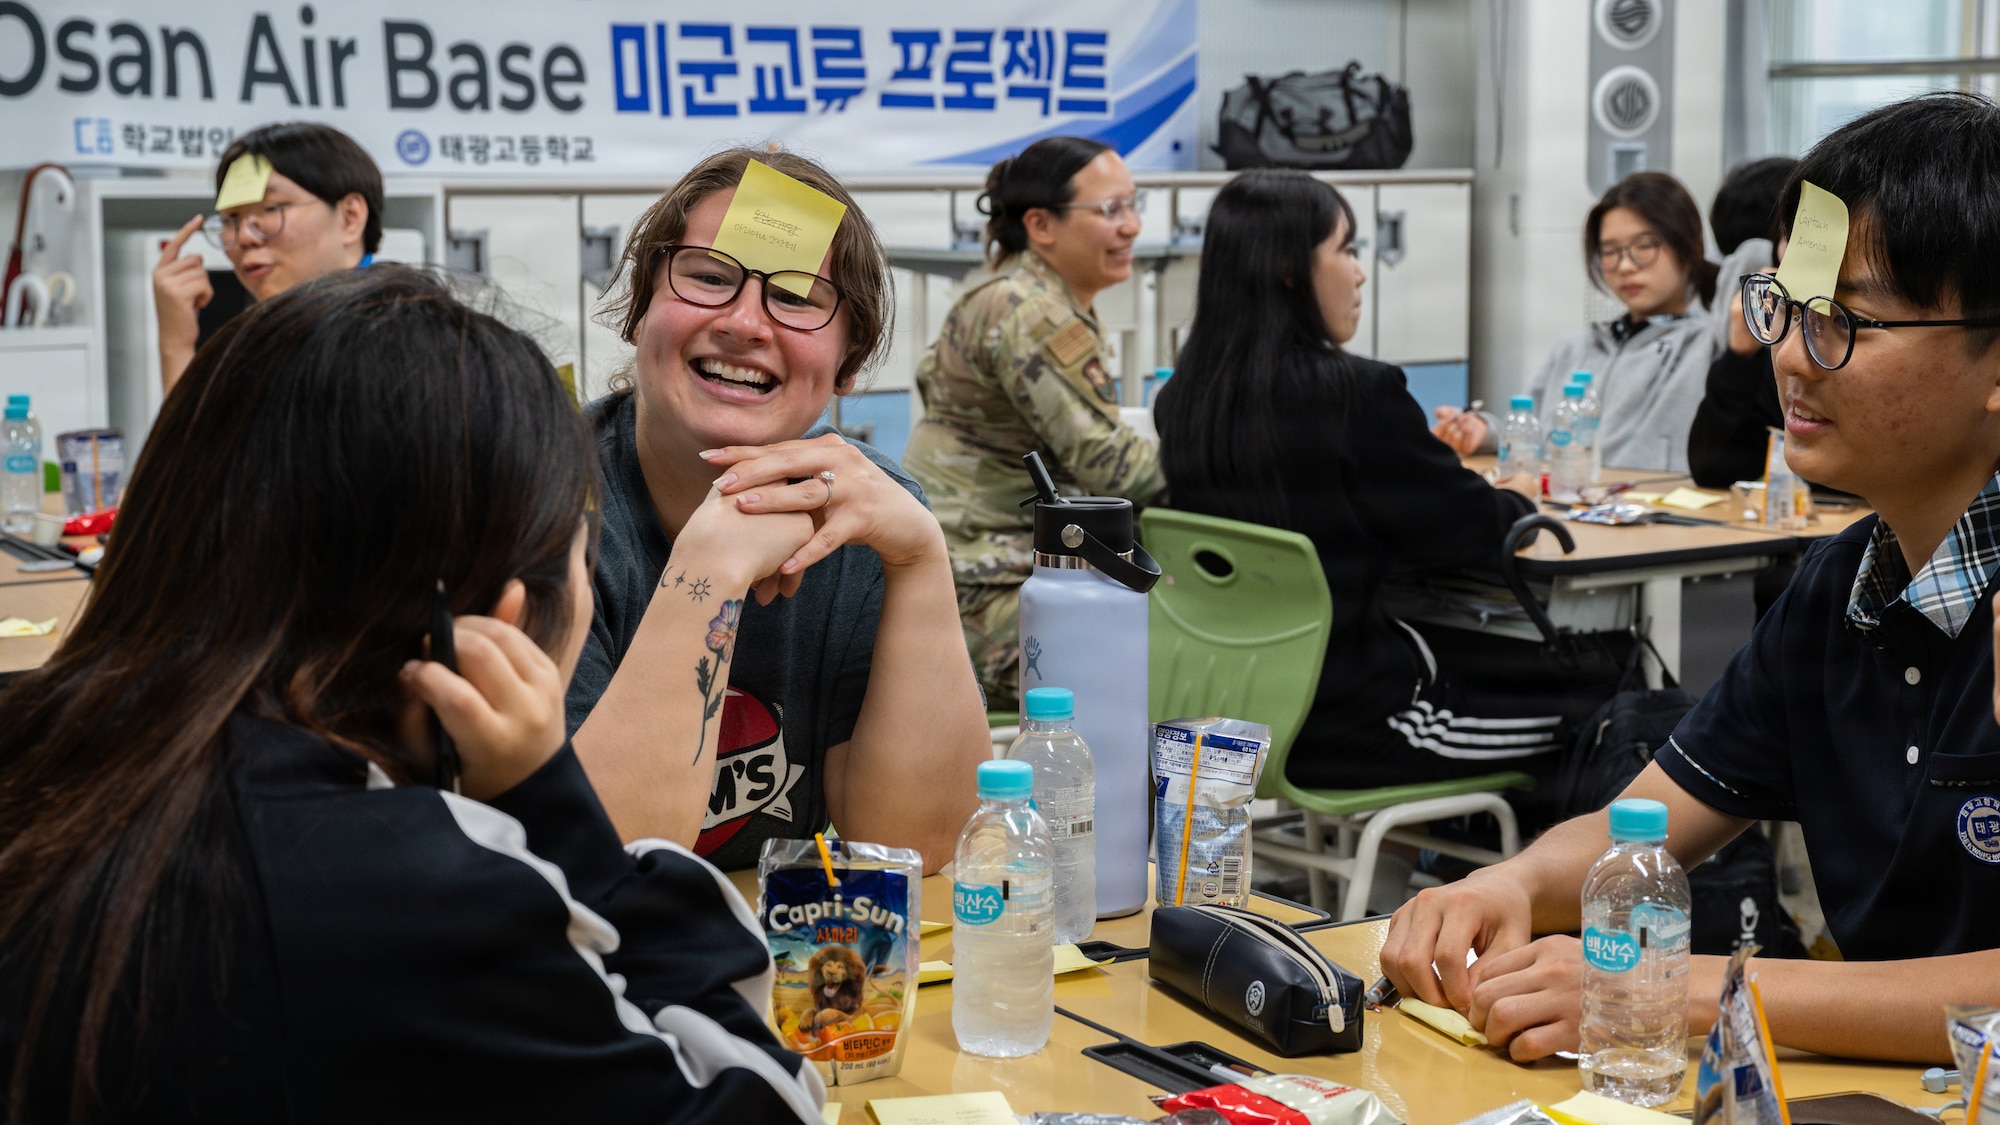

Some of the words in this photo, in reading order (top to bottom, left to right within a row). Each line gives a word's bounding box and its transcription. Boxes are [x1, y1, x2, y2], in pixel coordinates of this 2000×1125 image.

[0, 1, 214, 98] Osan
[240, 5, 356, 108] Air
[383, 20, 587, 112] Base
[610, 23, 867, 117] 미군교류
[880, 29, 1108, 117] 프로젝트
[439, 134, 596, 165] 태광고등학교
[1799, 208, 1829, 230] Captain
[1797, 236, 1827, 253] America
[1157, 727, 1188, 741] 영양정보
[954, 891, 999, 915] 백산수
[768, 893, 905, 937] Capri-Sun
[815, 926, 859, 944] 사파리
[1586, 935, 1636, 964] 백산수
[843, 1037, 880, 1051] 비타민C
[840, 1062, 854, 1070] 200
